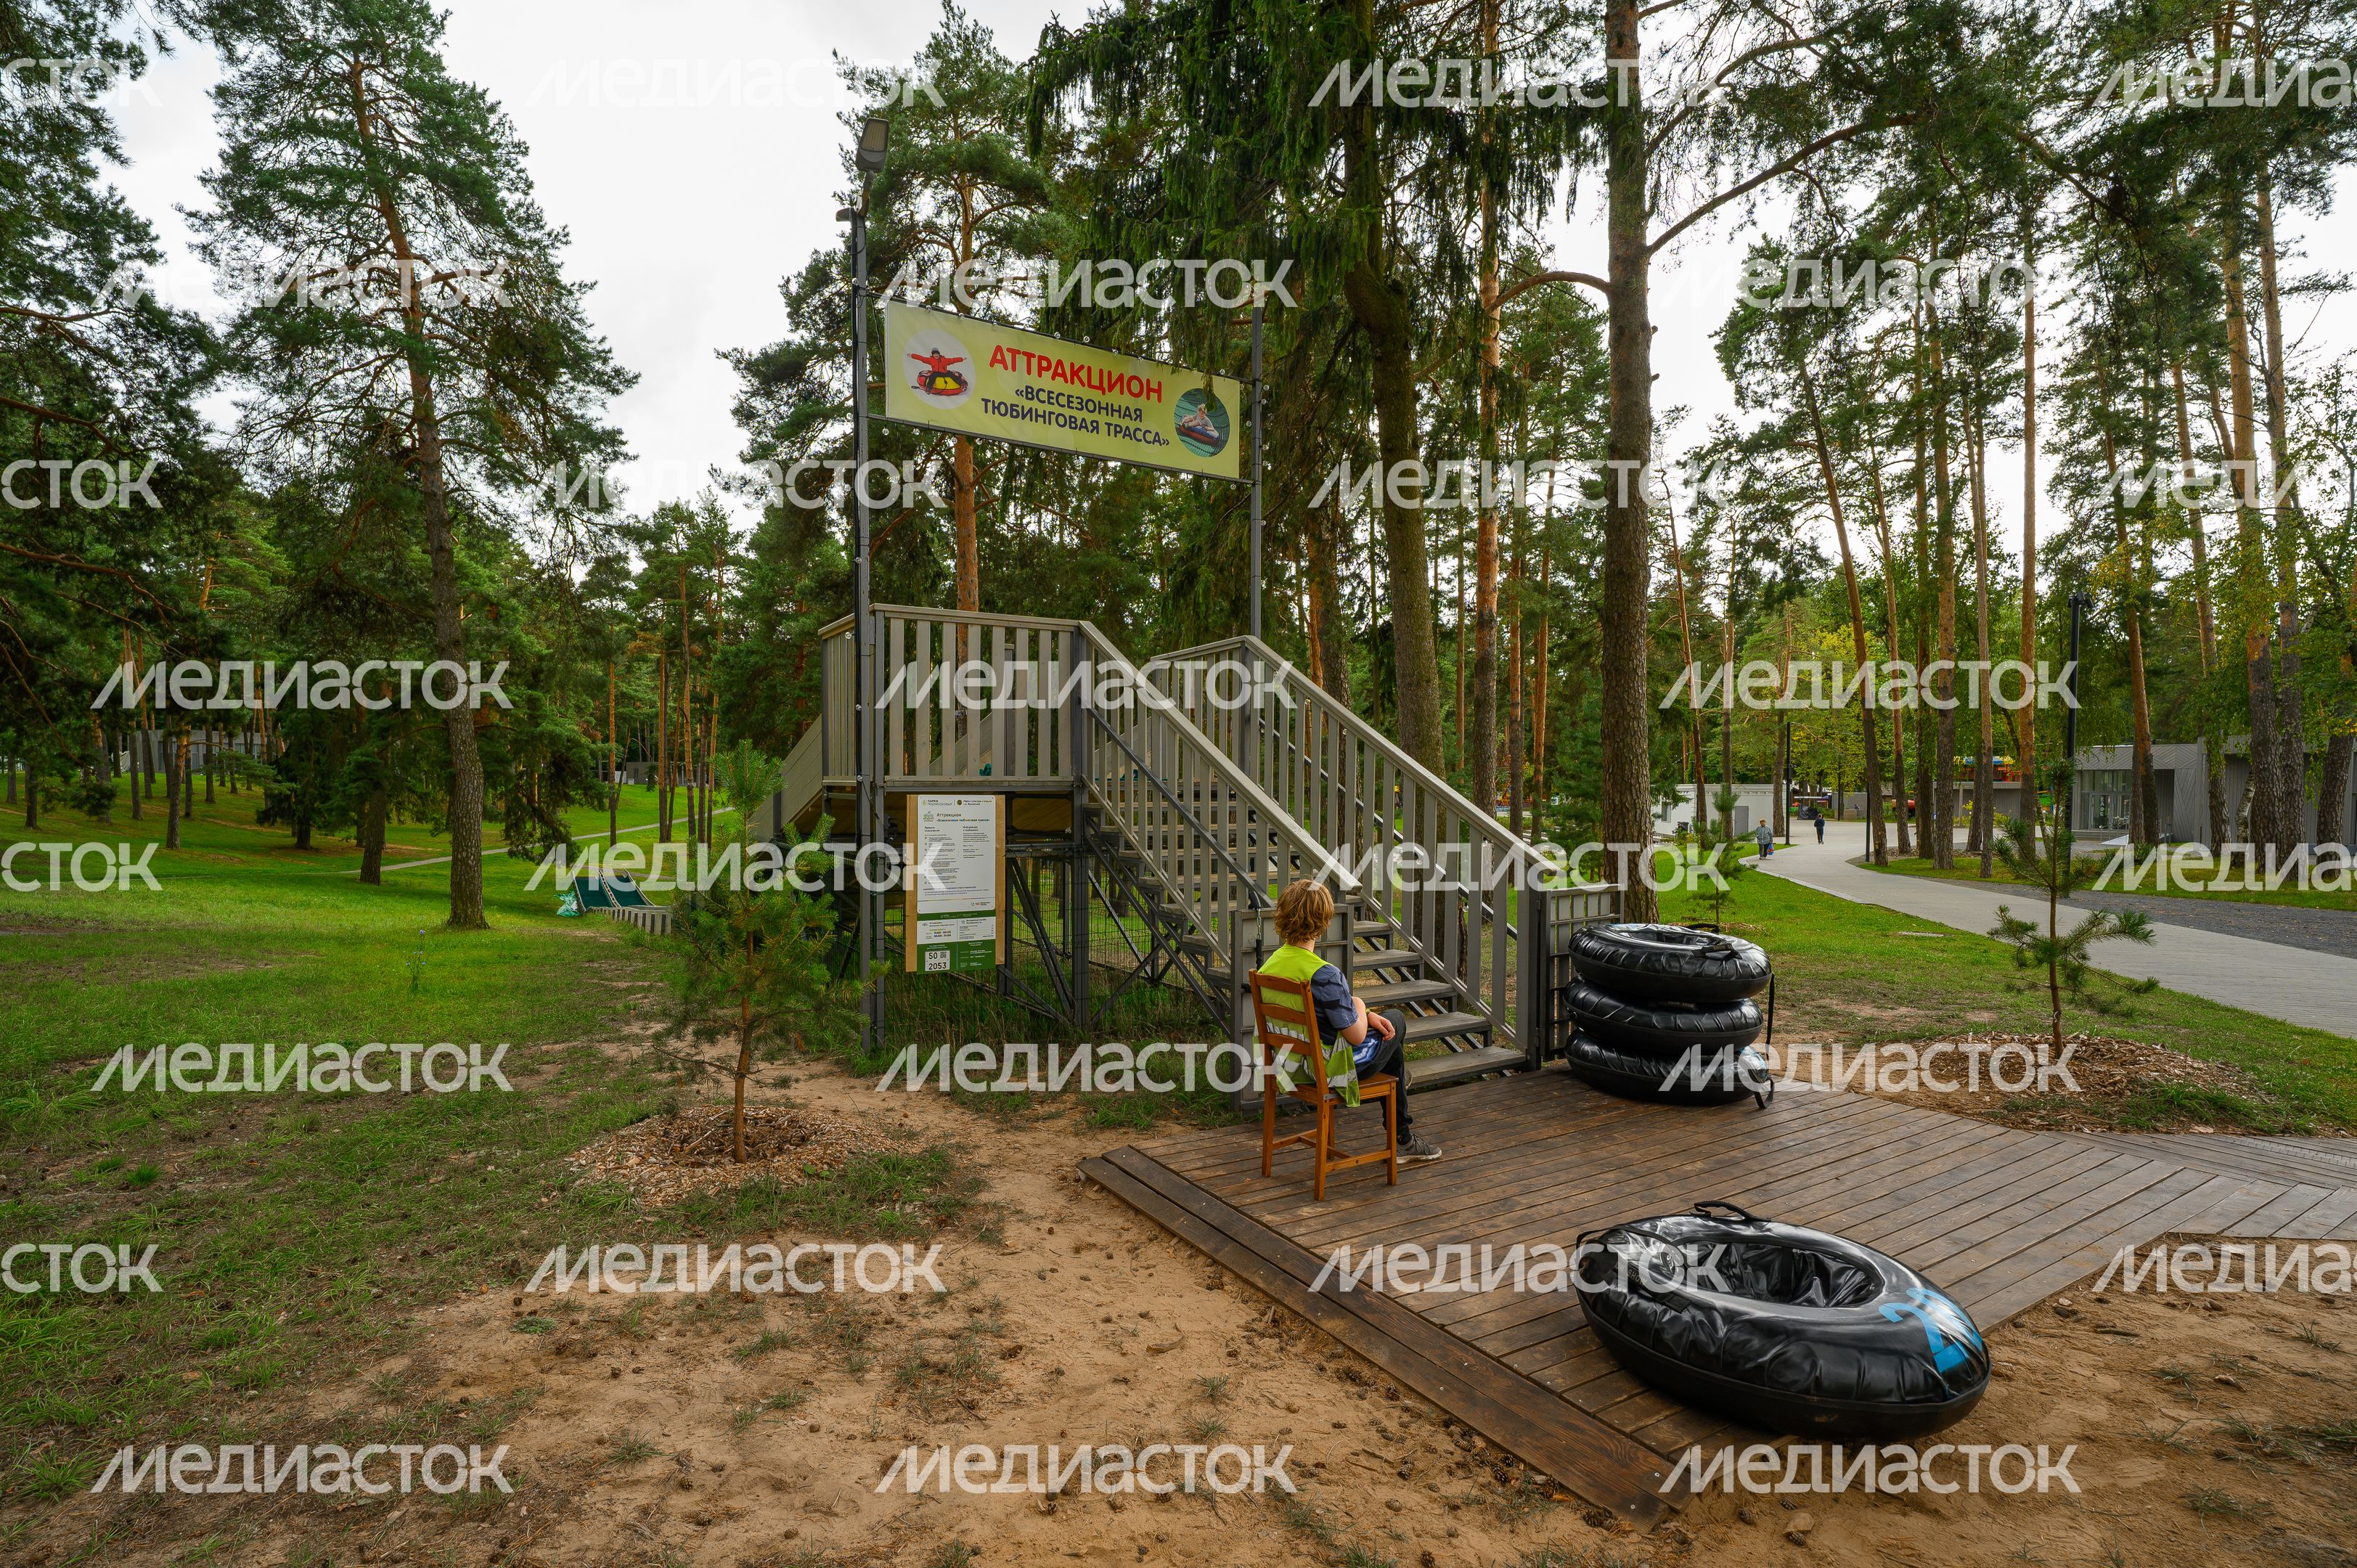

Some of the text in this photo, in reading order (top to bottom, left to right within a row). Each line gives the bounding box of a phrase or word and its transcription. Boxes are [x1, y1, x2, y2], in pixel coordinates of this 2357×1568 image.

[989, 345, 1162, 404] АТТРАКЦИОН
[981, 398, 1170, 446] ТЮБИНГОВАЯ ТРАССА»
[1015, 385, 1143, 422] «ВСЕСЕЗОННАЯ
